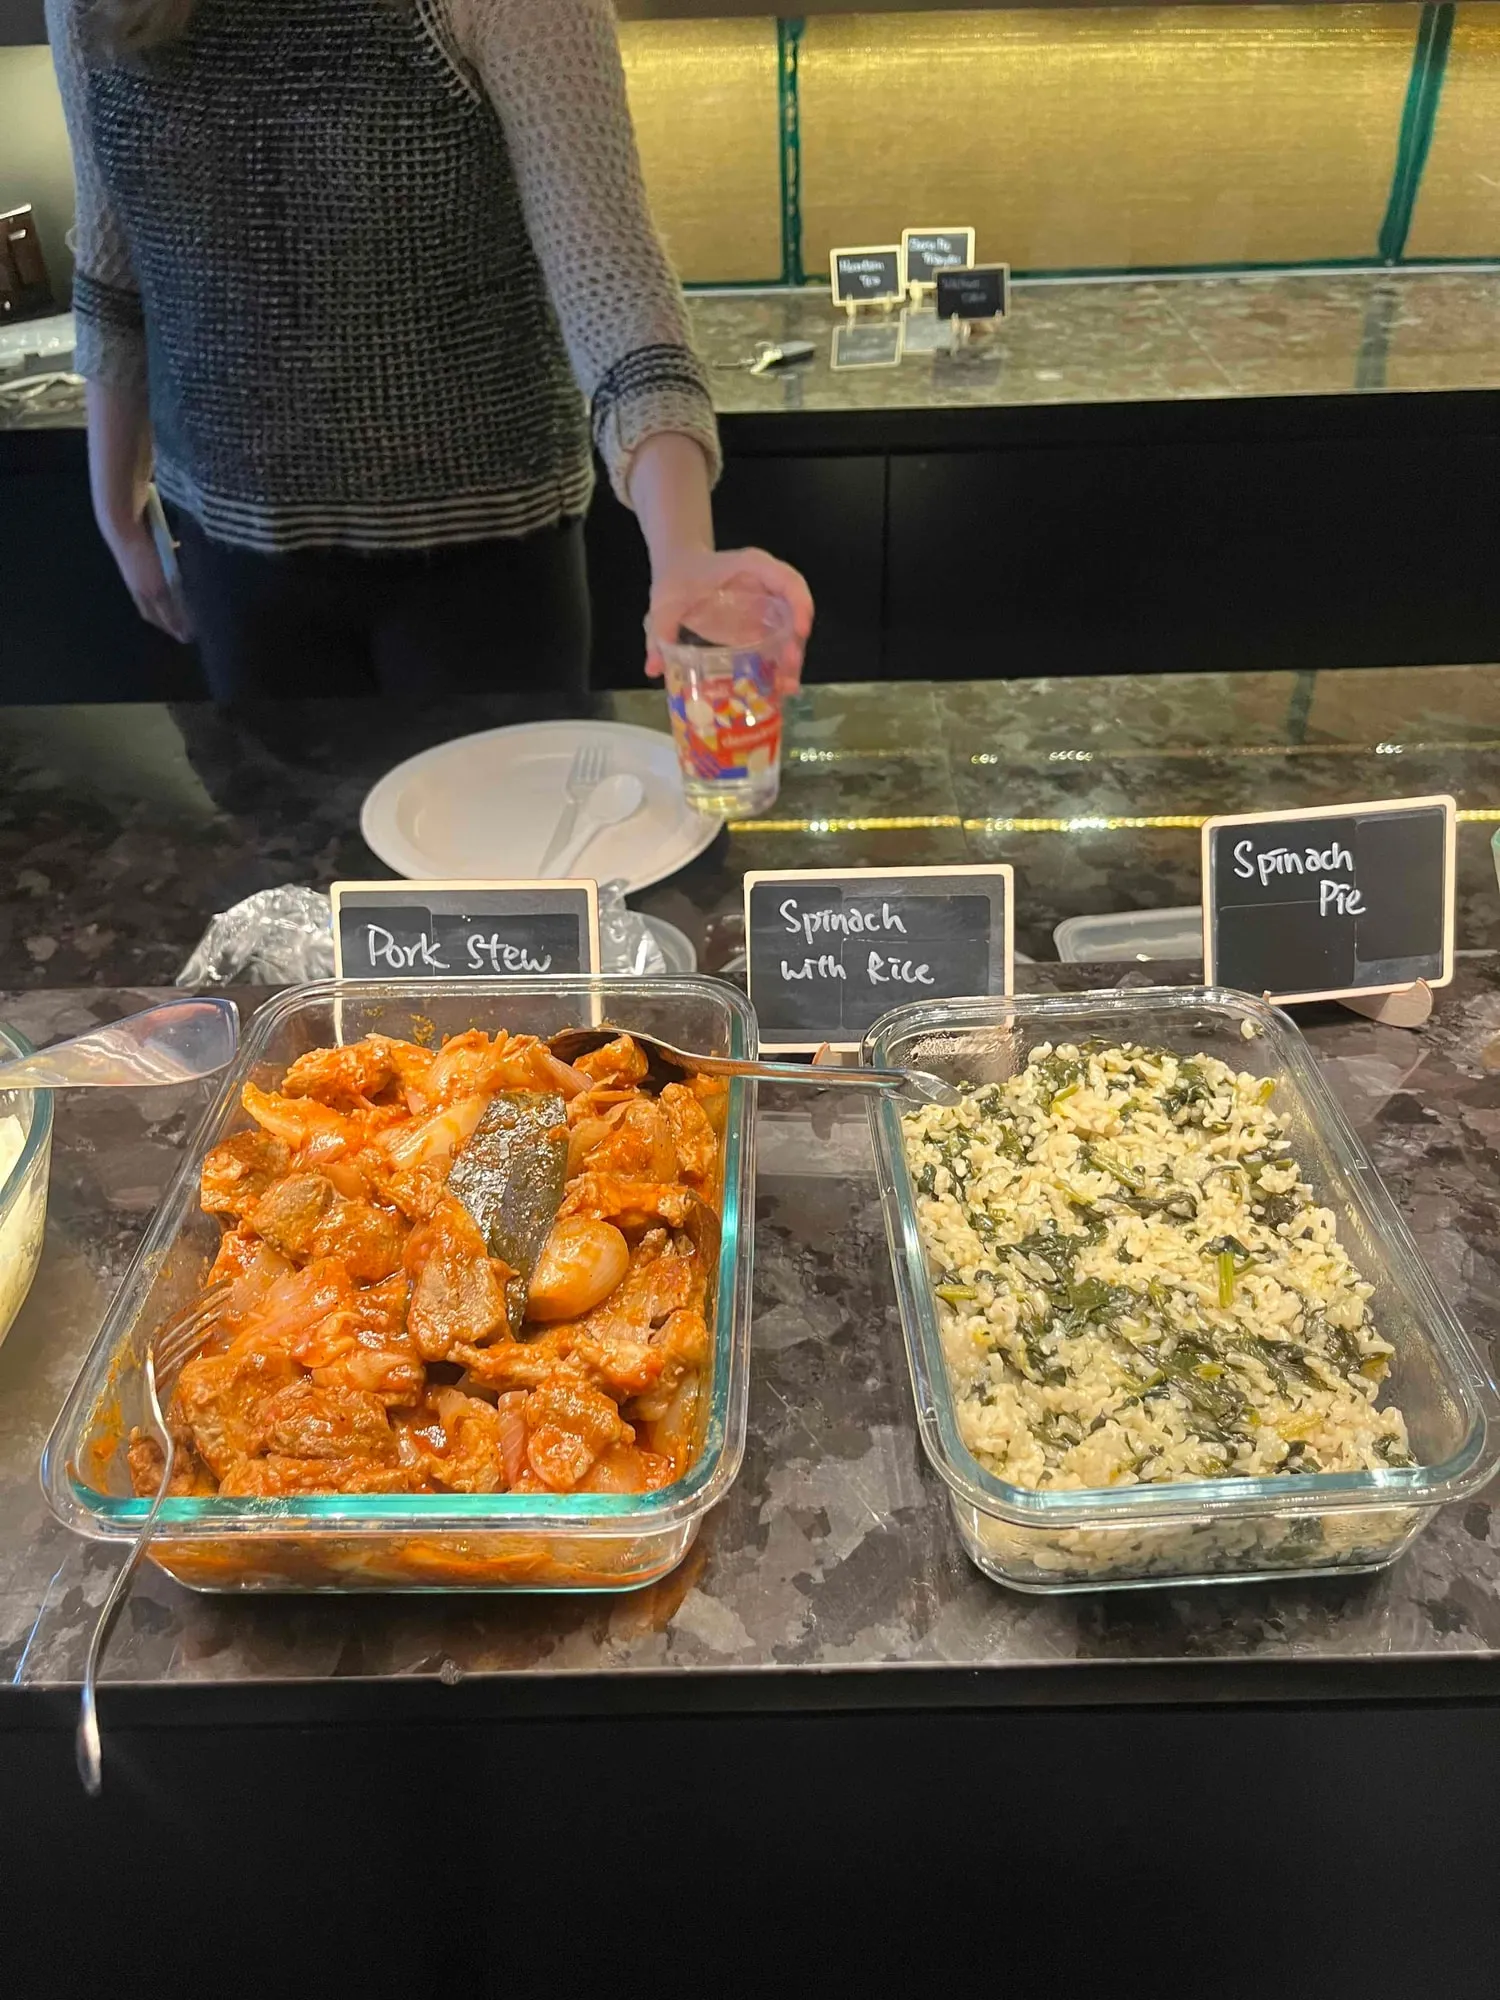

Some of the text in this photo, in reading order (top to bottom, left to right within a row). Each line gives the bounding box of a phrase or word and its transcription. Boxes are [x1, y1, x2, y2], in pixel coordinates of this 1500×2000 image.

[1233, 840, 1354, 887] Spinach
[779, 898, 908, 945] Spinach
[1319, 879, 1367, 917] Pie
[367, 923, 553, 973] Pork Stew
[780, 950, 936, 985] with Rice
